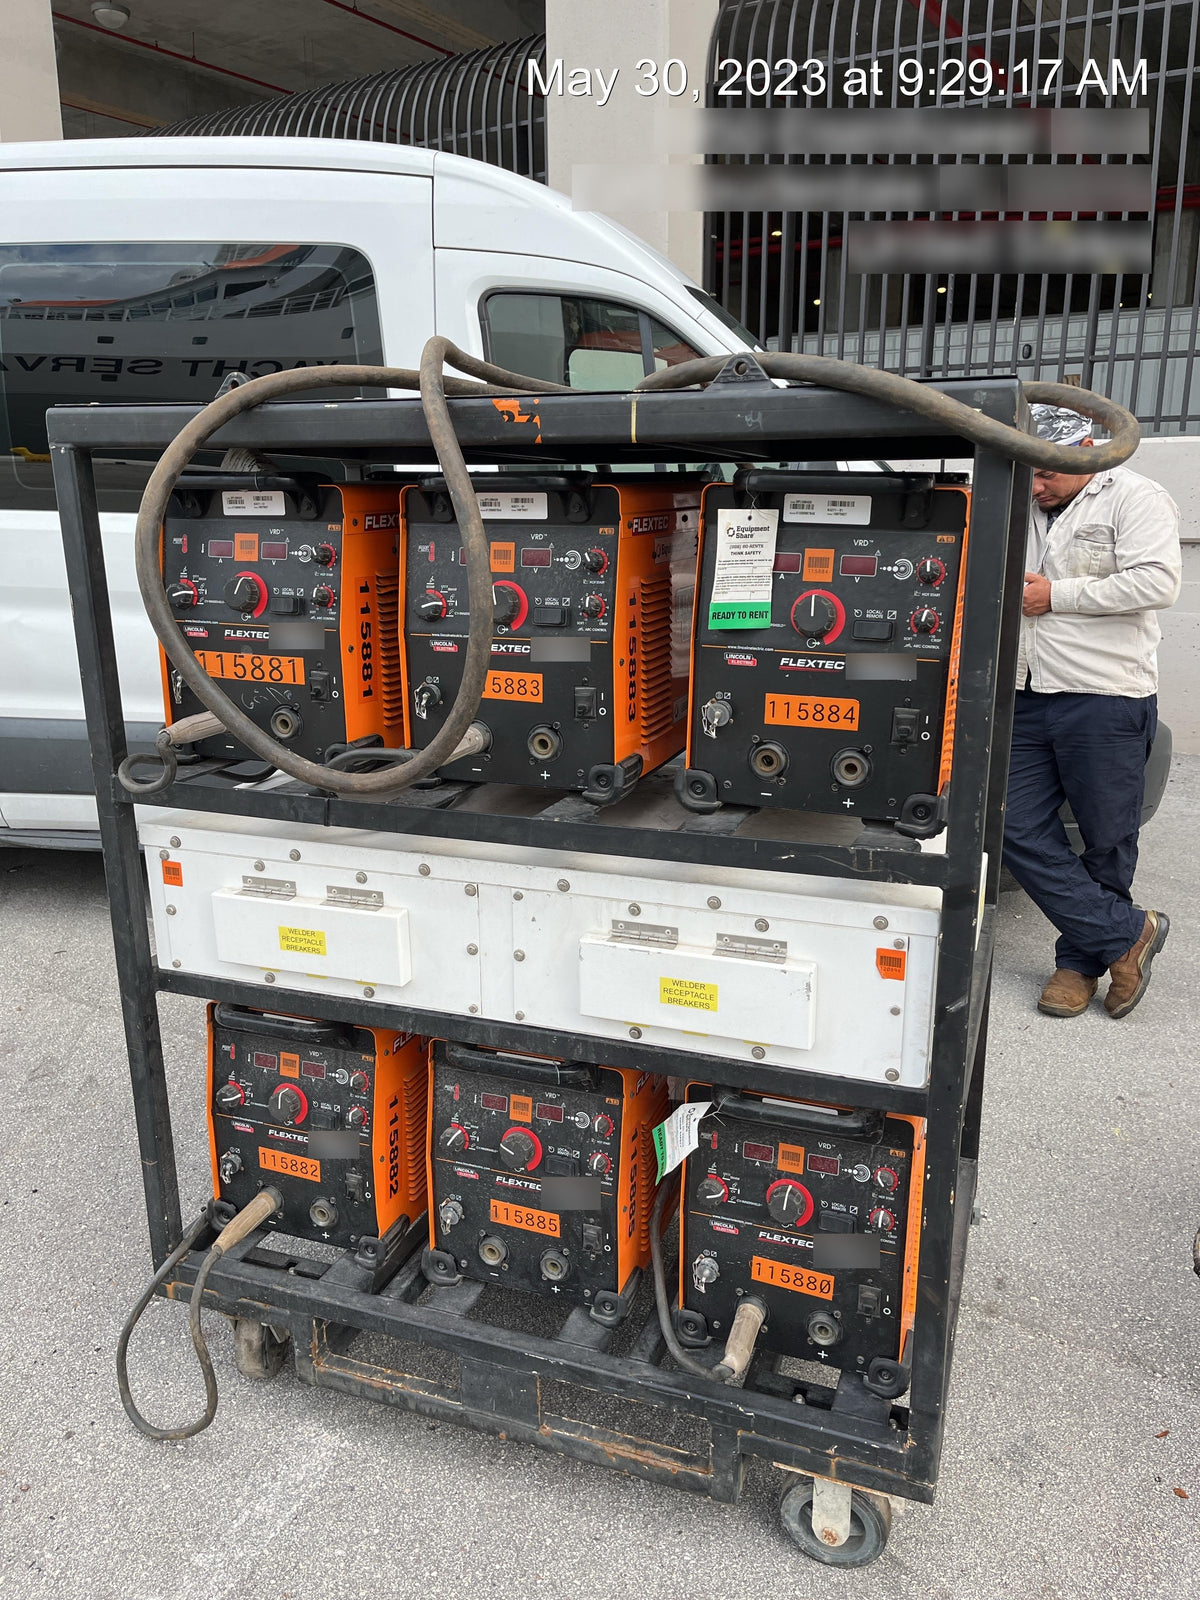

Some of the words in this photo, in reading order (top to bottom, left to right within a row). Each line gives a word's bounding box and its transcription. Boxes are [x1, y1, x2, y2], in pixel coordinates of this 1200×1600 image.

[365, 514, 399, 530] FLEX
[632, 516, 669, 533] FLEXTEC
[736, 525, 770, 533] Equipment
[712, 611, 735, 621] READY
[738, 611, 747, 619] TO
[749, 610, 769, 619] RENT
[225, 629, 270, 639] FLEXTEC
[360, 580, 373, 698] 115881
[491, 644, 531, 653] EXTEC
[628, 592, 637, 723] 115883
[780, 657, 846, 670] FLEXTEC
[199, 652, 296, 683] 115881
[492, 677, 540, 697] 5883
[769, 700, 855, 724] 115884
[288, 928, 316, 937] WELDER
[282, 935, 324, 947] RECEPTACLE
[286, 944, 321, 954] BREAKERS
[672, 979, 706, 990] WELDER
[663, 987, 715, 1001] RECEPTACLE
[667, 997, 710, 1009] BREAKERS
[269, 1130, 308, 1143] FLEXTEC
[389, 1095, 399, 1200] 115882
[261, 1152, 318, 1177] 115882
[496, 1176, 542, 1191] FLEXTEC
[493, 1205, 557, 1232] 115885
[711, 1220, 734, 1229] LINCOLN
[759, 1231, 814, 1249] FLEXTEC
[756, 1263, 831, 1294] 115880
